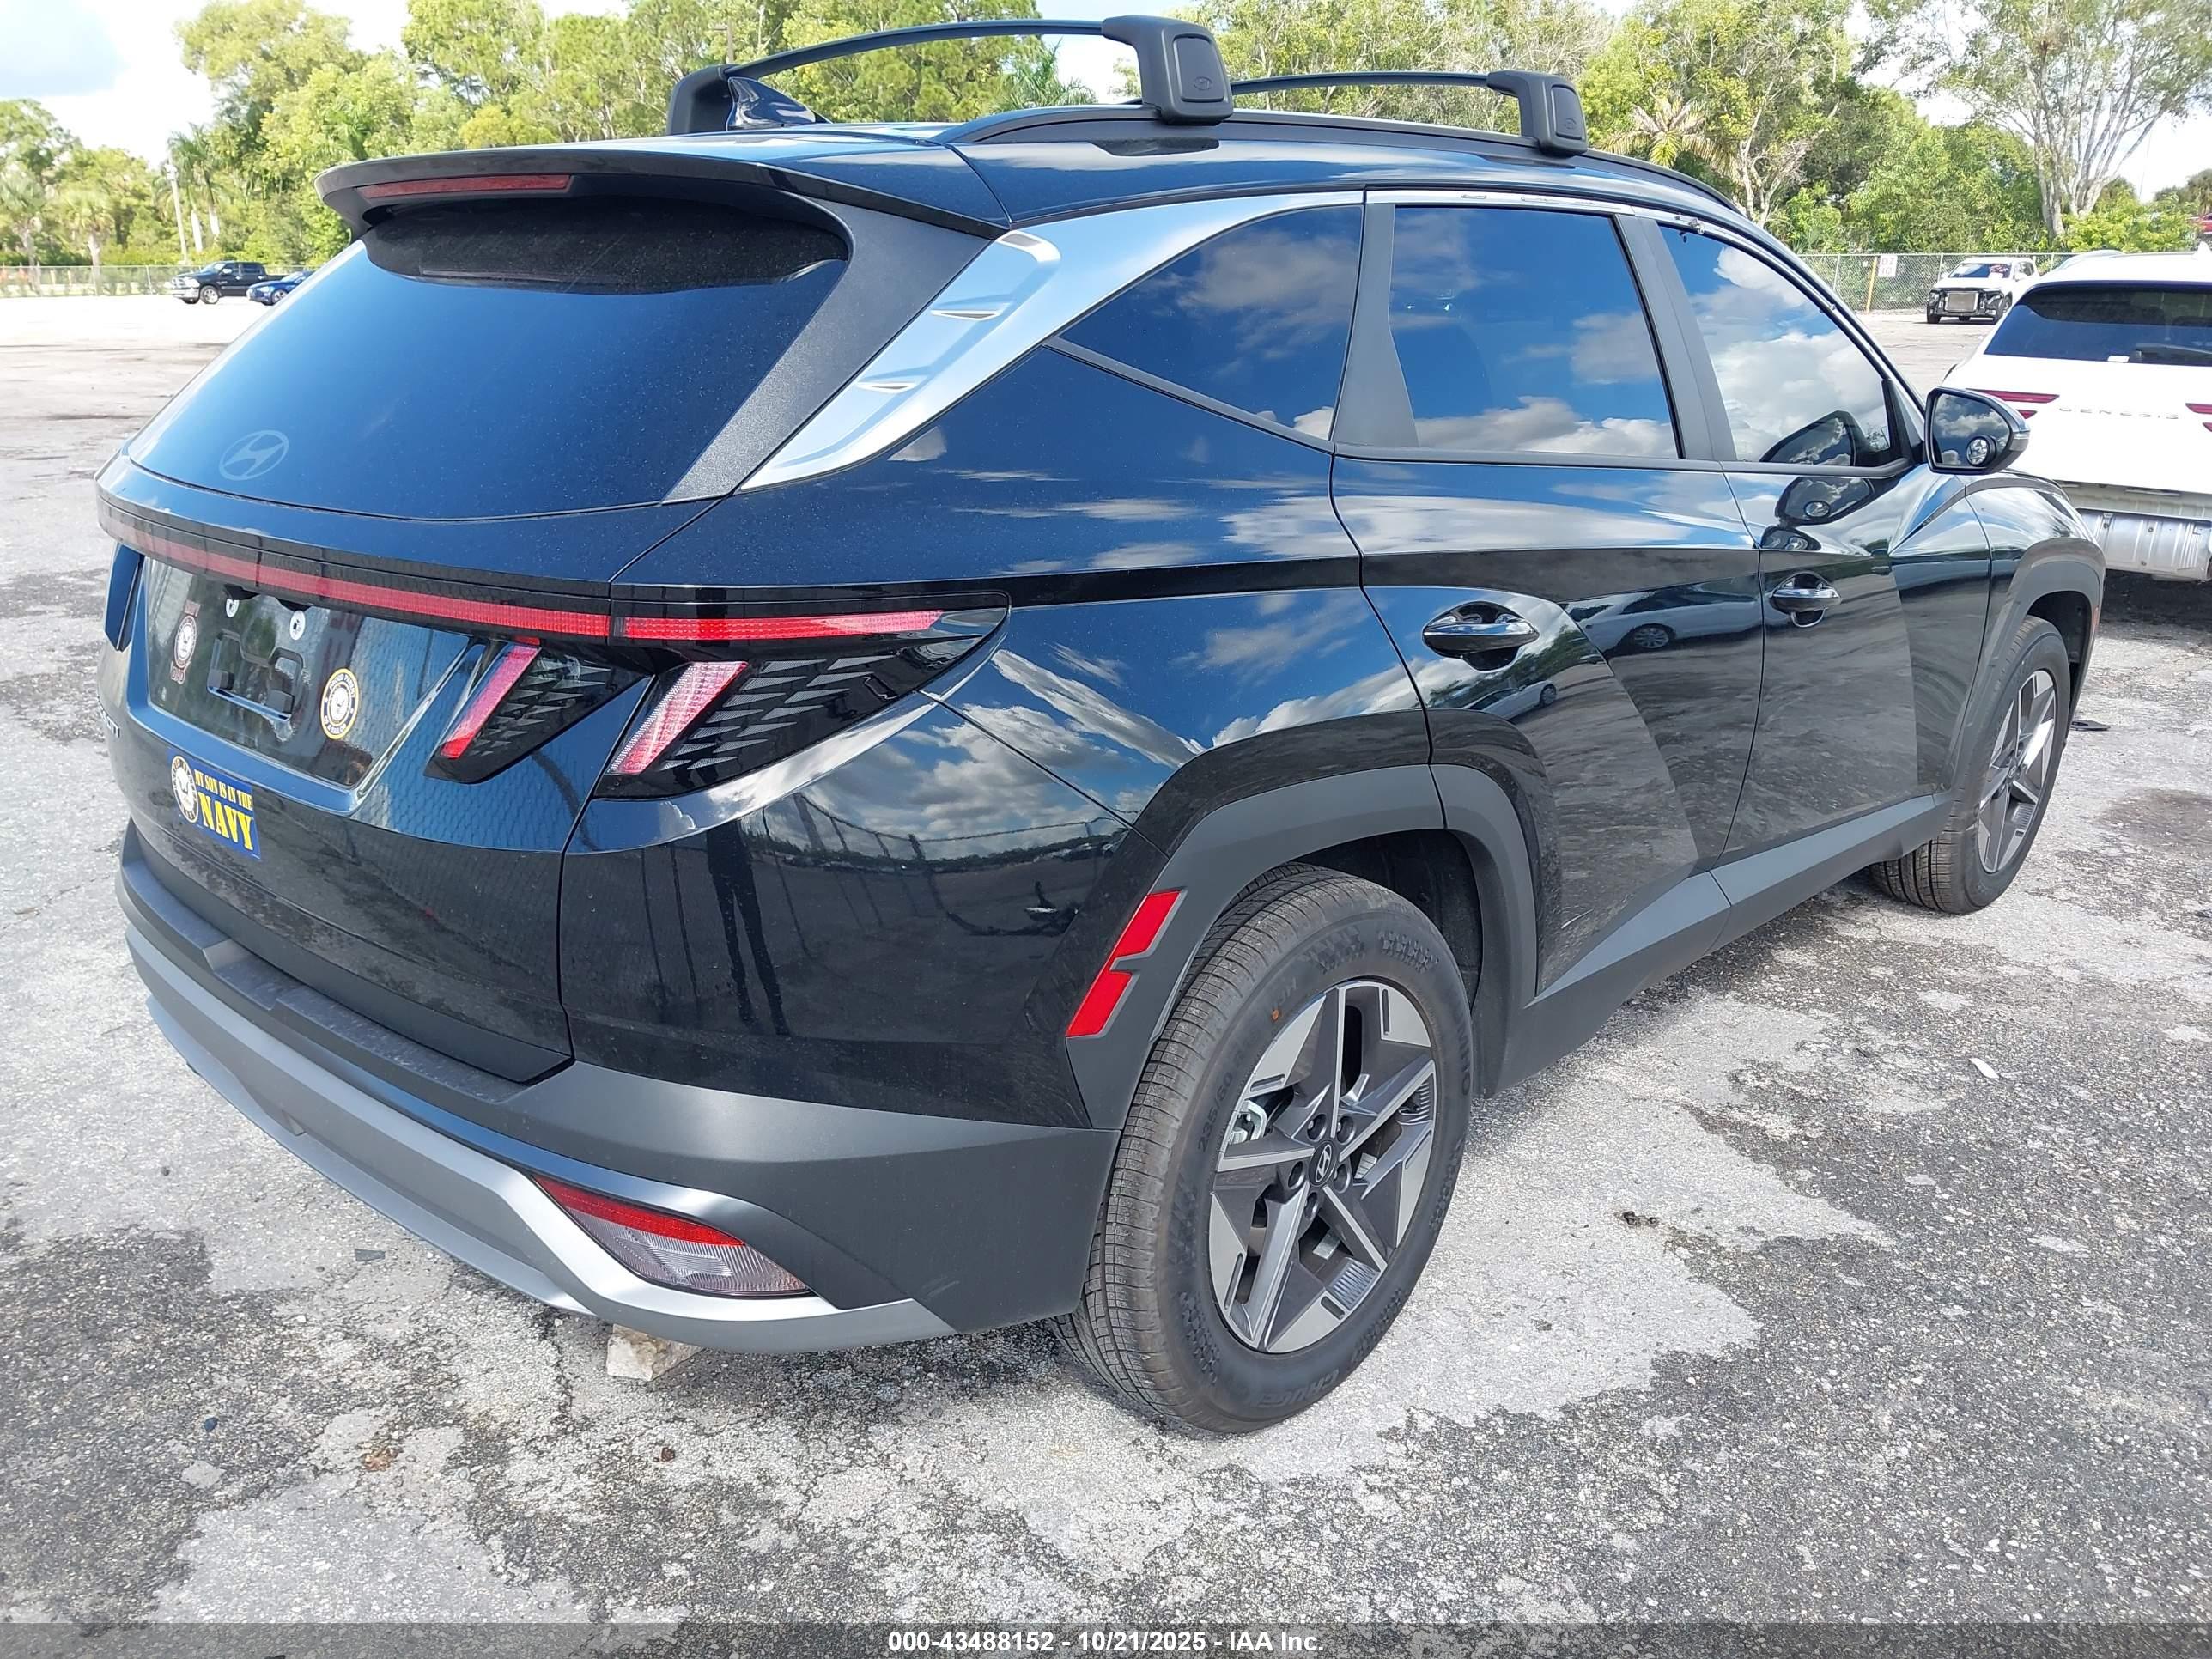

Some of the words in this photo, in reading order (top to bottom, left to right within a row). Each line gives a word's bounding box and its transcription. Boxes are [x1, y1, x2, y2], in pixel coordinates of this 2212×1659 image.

[193, 769, 204, 787] MY
[204, 774, 219, 795] SON
[218, 781, 227, 799] IS
[227, 785, 237, 804] IN
[236, 789, 253, 811] THE
[198, 791, 255, 850] NAVY
[1196, 1073, 1234, 1152] 235/60
